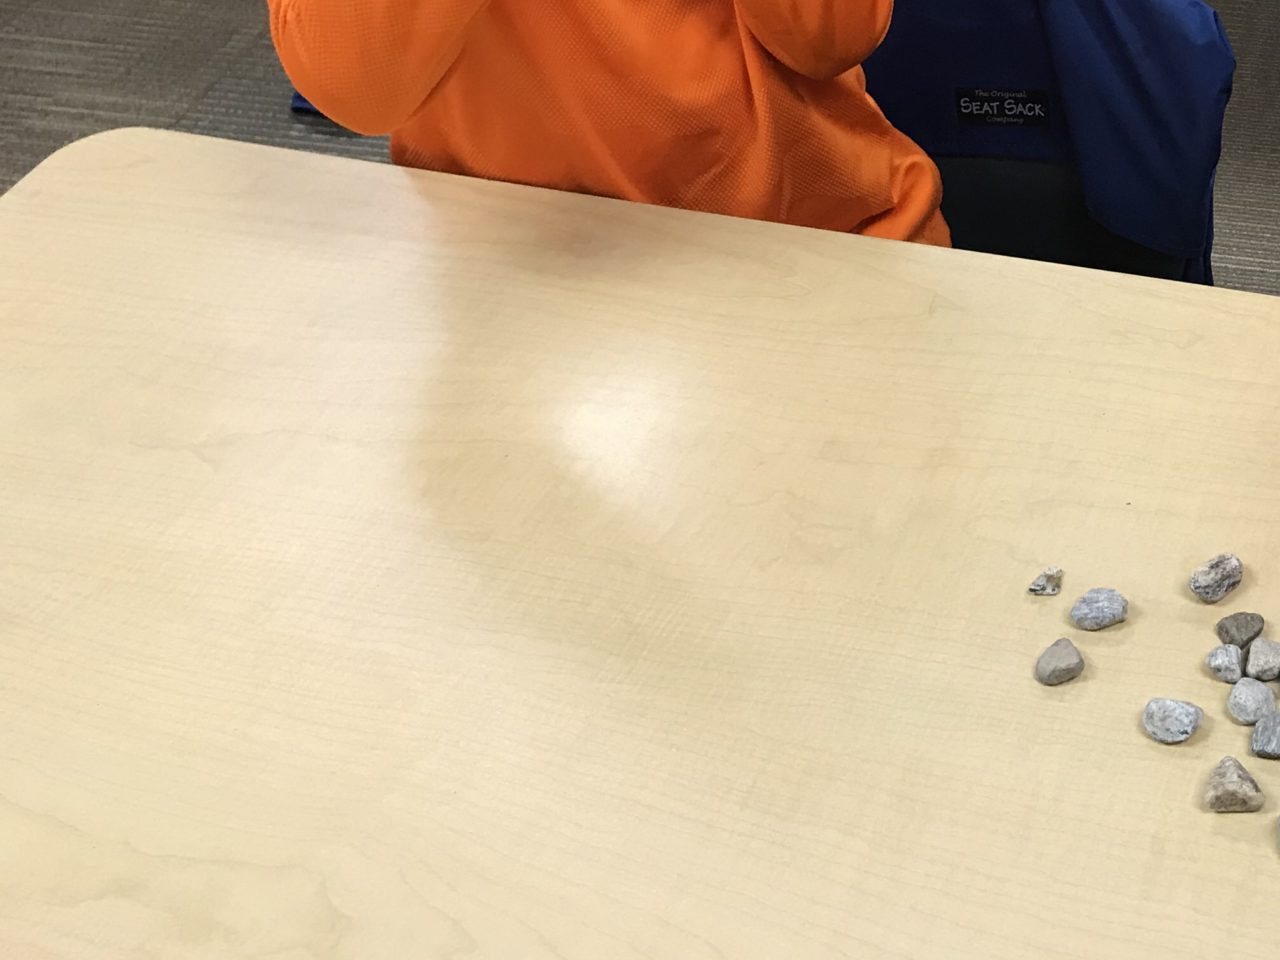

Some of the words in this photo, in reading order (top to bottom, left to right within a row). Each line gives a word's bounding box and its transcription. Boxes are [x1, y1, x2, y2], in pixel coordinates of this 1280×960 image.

[975, 89, 989, 97] The
[991, 90, 1027, 98] Original
[960, 97, 999, 114] SEAT
[1004, 99, 1045, 117] SACK
